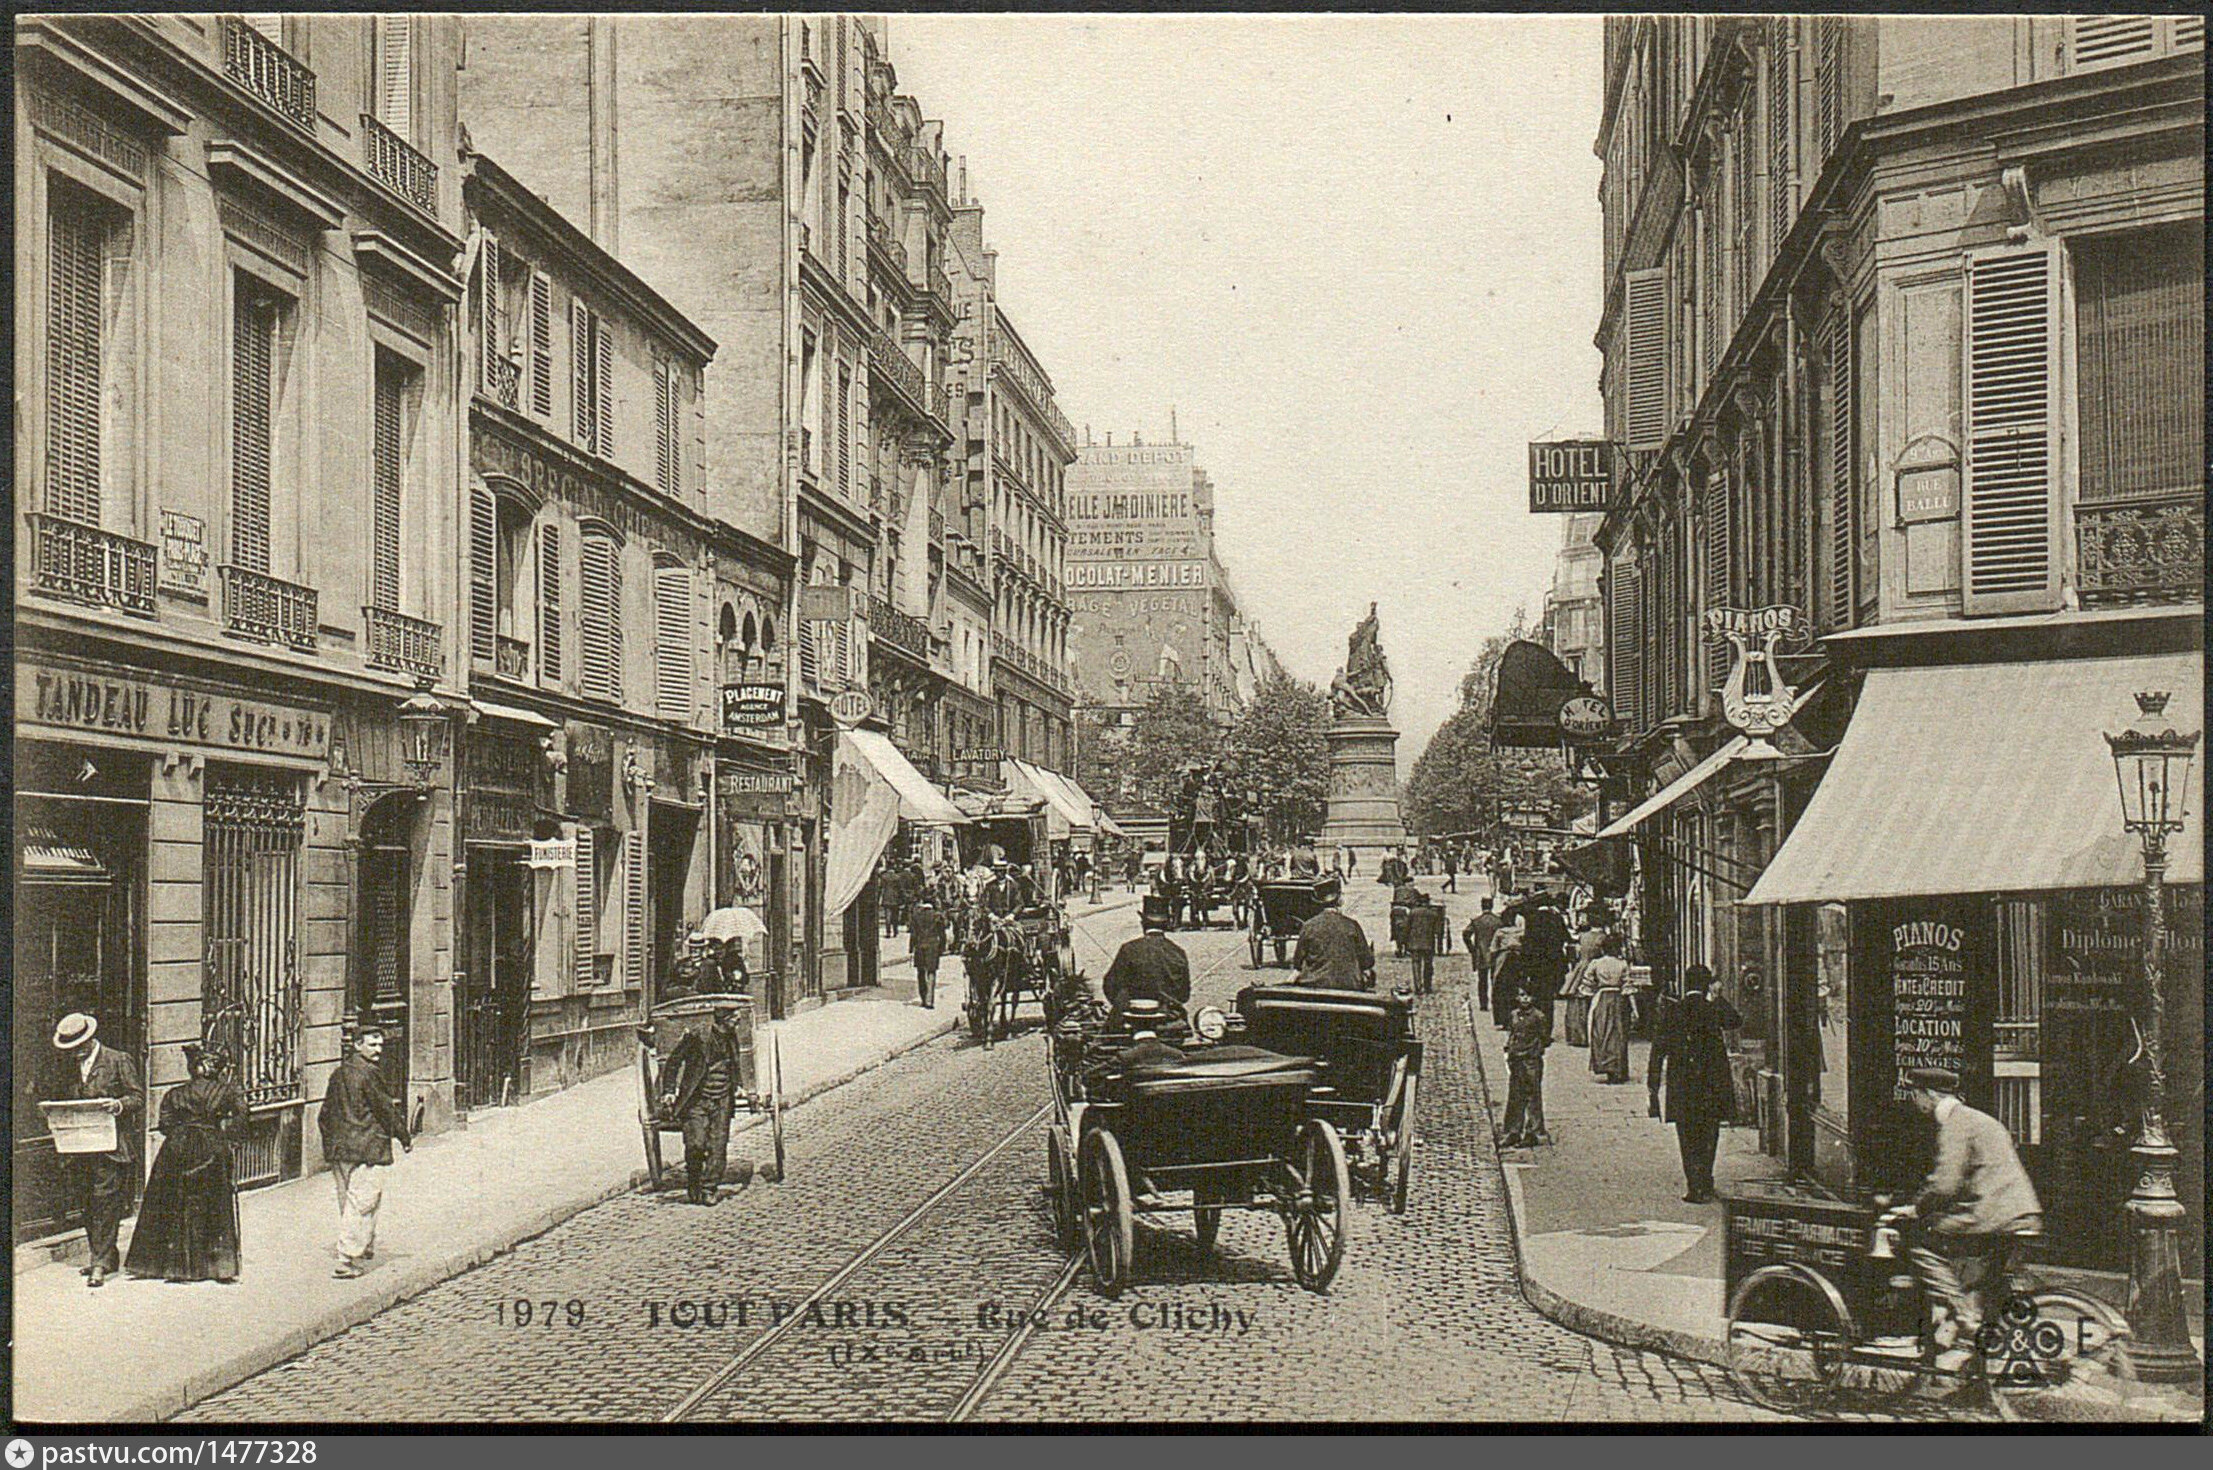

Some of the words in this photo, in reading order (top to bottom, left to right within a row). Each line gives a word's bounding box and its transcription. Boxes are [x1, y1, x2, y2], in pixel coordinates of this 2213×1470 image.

[1535, 449, 1607, 477] HOTEL
[1535, 482, 1607, 504] D'ORIENT
[1917, 480, 1941, 491] RUE
[1907, 496, 1951, 511] BALLU
[1708, 607, 1793, 634] PIANOS
[36, 671, 150, 732] TANDEAU
[167, 691, 211, 739] LUC
[724, 687, 784, 705] PLACEMENT
[834, 694, 869, 717] HOTEL
[728, 710, 780, 725] AMSTERDAM
[953, 750, 1007, 761] LAVATORY
[730, 775, 794, 794] RESTAURANT
[534, 847, 575, 860] FUMISTERIE
[1893, 921, 1965, 952] PIANOS
[1895, 1016, 1961, 1037] LOCATION
